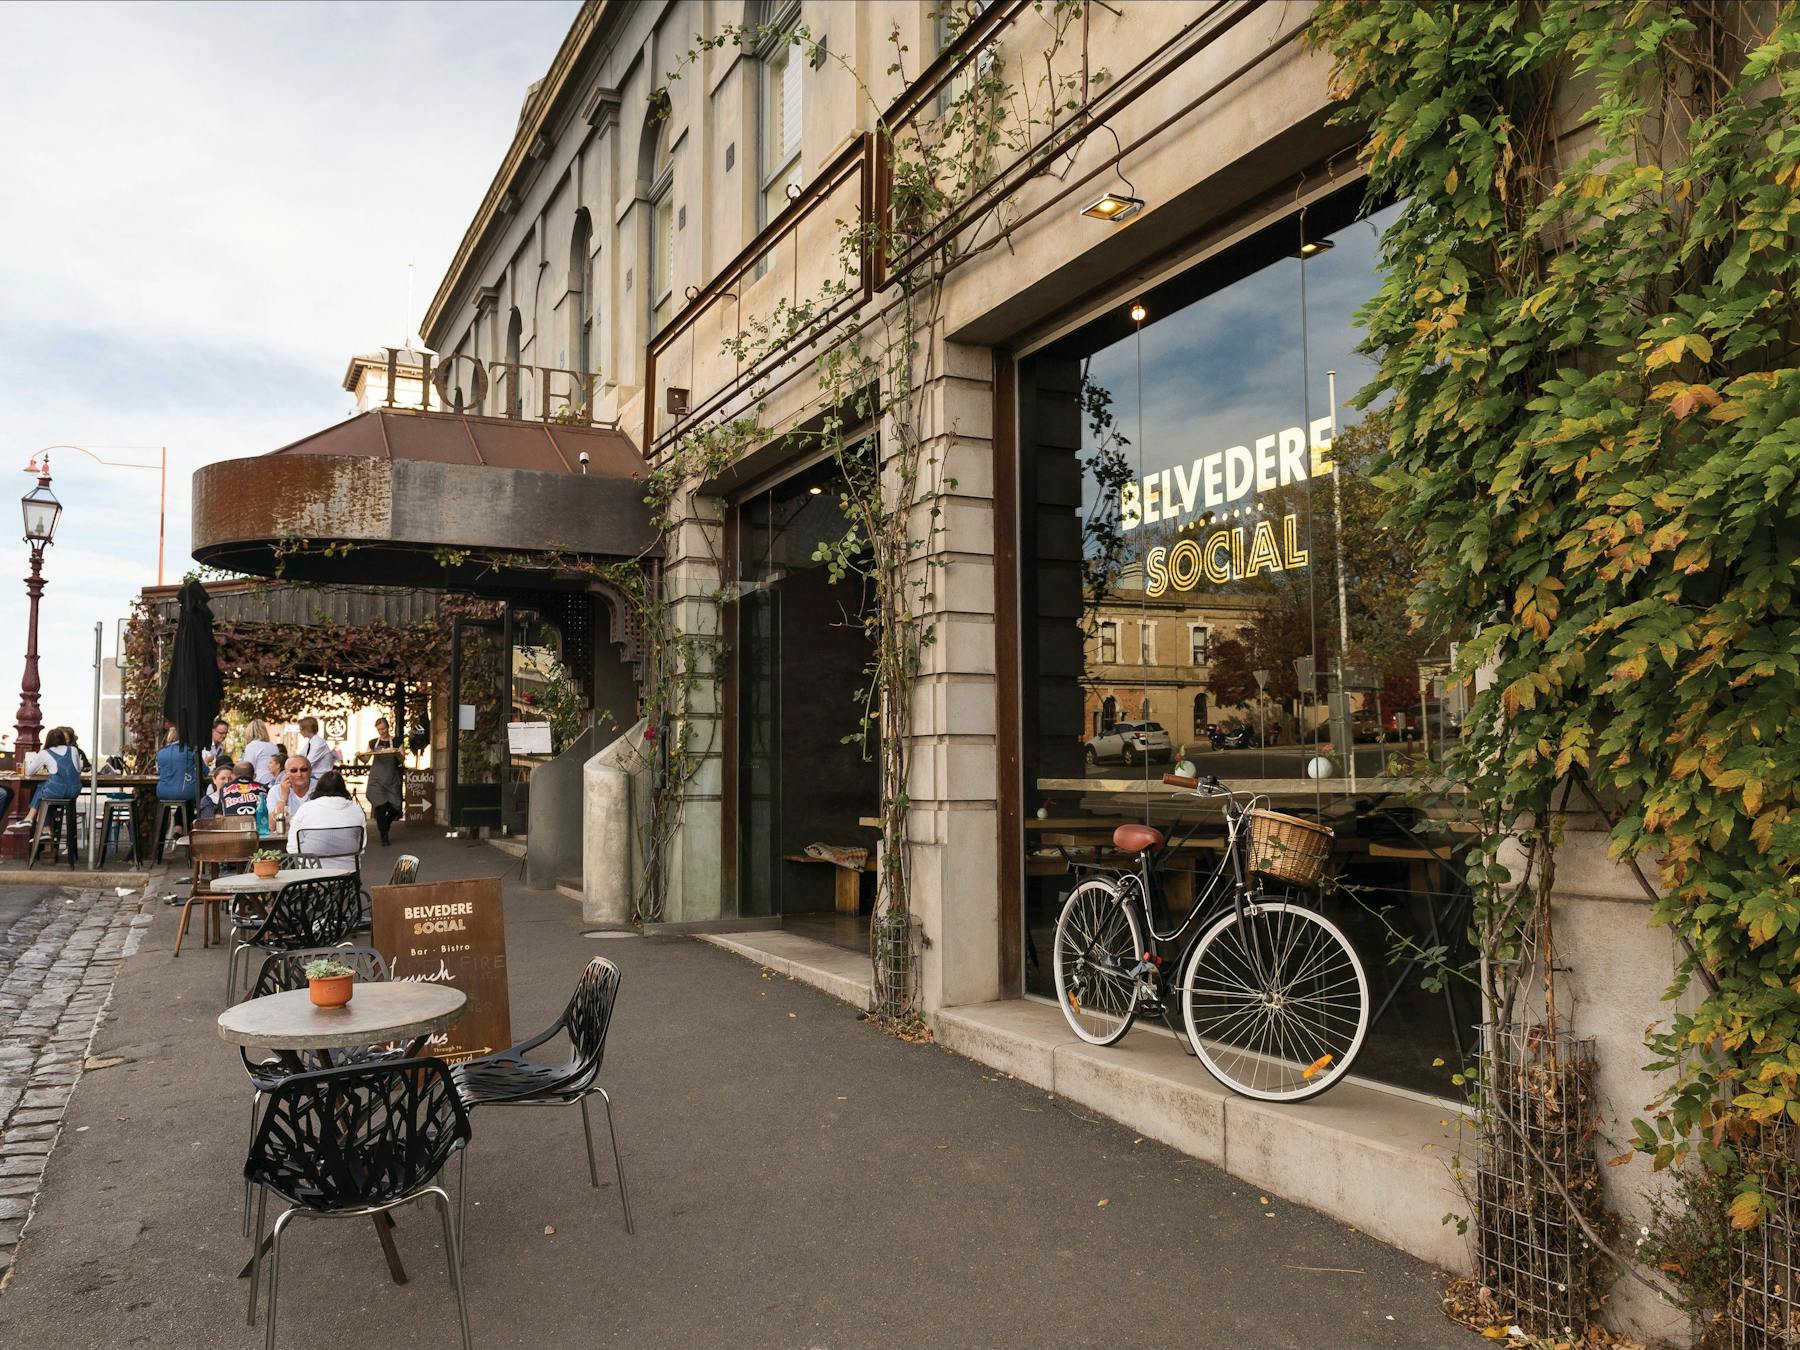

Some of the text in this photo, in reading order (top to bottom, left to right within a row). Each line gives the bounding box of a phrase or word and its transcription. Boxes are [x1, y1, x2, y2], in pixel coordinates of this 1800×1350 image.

[381, 346, 622, 431] HOTEL
[1121, 416, 1334, 531] BELVEDERE
[1146, 514, 1309, 597] SOCIAL
[224, 793, 246, 808] Red
[404, 902, 473, 919] BELVEDERE
[413, 918, 467, 935] SOCIAL
[411, 944, 470, 956] Bar Bistro
